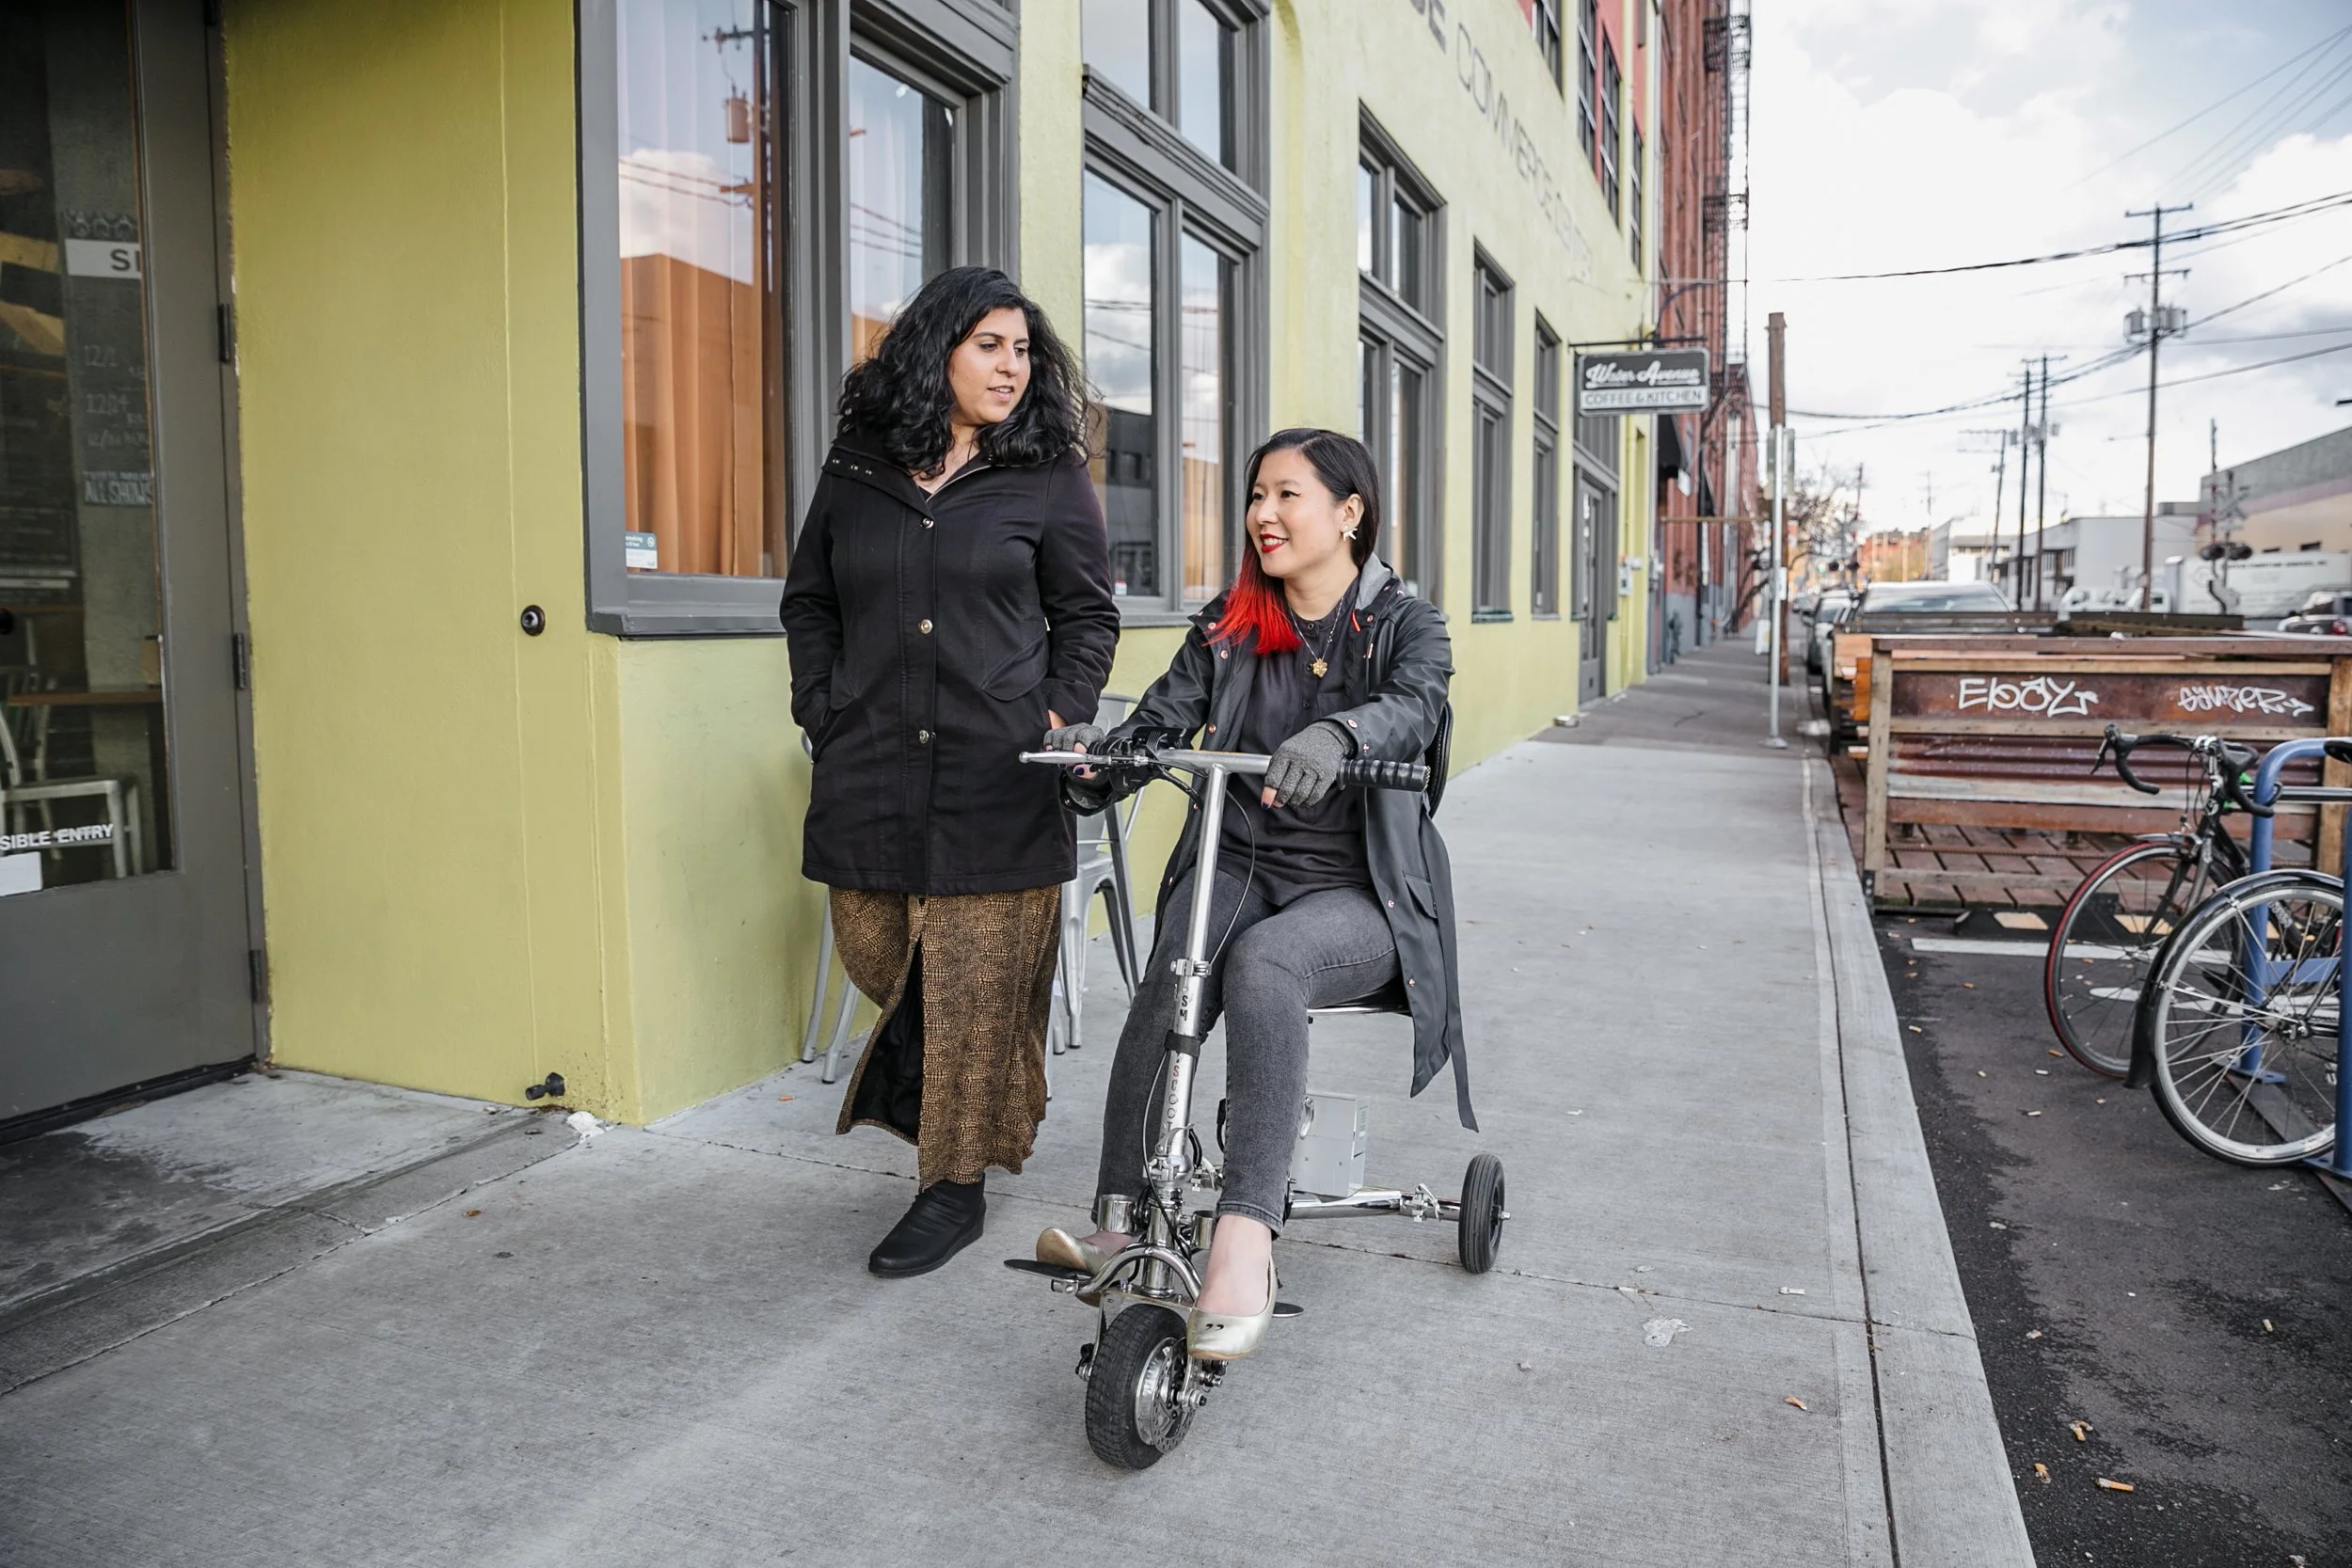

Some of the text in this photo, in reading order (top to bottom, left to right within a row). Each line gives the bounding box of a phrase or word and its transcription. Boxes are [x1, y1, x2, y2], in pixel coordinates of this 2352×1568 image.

[1584, 390, 1632, 405] COFFEE
[1646, 388, 1702, 404] KITCHEN
[0, 823, 114, 851] SIBLE ENTRY
